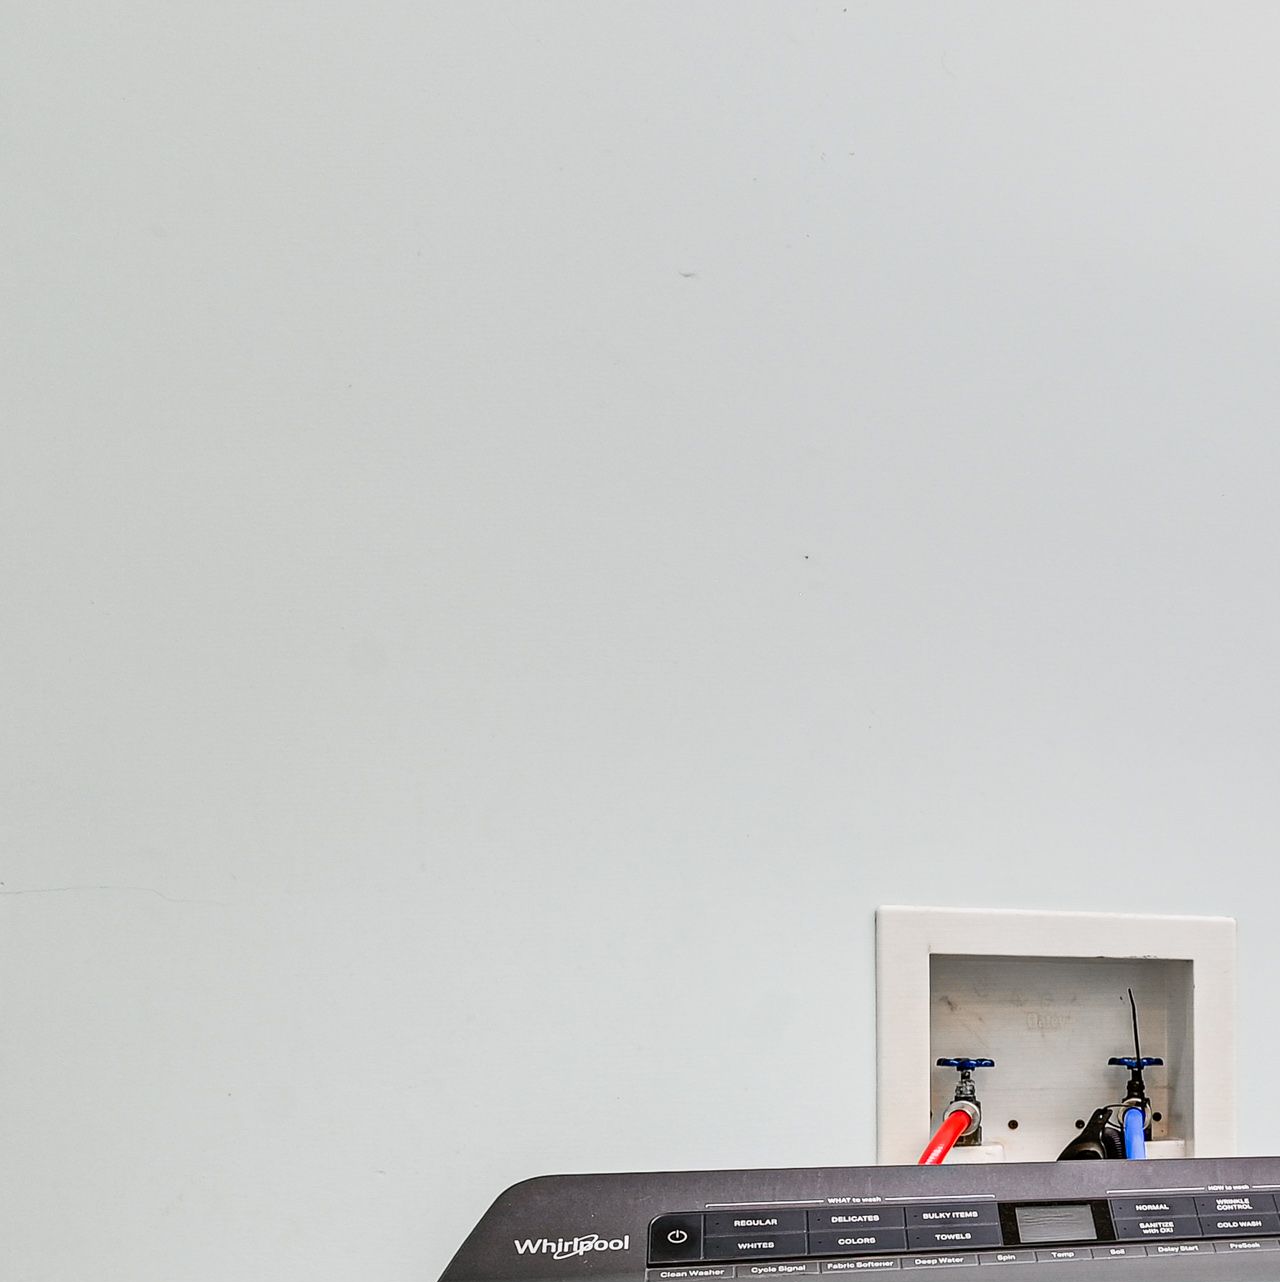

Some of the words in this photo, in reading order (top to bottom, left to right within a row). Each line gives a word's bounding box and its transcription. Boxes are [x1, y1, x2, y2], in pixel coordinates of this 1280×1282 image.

[831, 1214, 879, 1223] DELICATES
[923, 1212, 951, 1220] BULKY
[734, 1218, 778, 1227] REGULAR
[838, 1237, 876, 1245] COLORS
[935, 1233, 971, 1241] TOWELS
[514, 1234, 630, 1260] Whirlpool
[737, 1242, 775, 1250] WHITES
[1051, 1251, 1075, 1259] Temp
[827, 1262, 855, 1270] Fabric
[856, 1261, 894, 1269] Softener
[915, 1258, 937, 1266] Deep
[689, 1269, 725, 1277] Washer
[751, 1266, 777, 1274] Cycle
[778, 1265, 806, 1273] Signal
